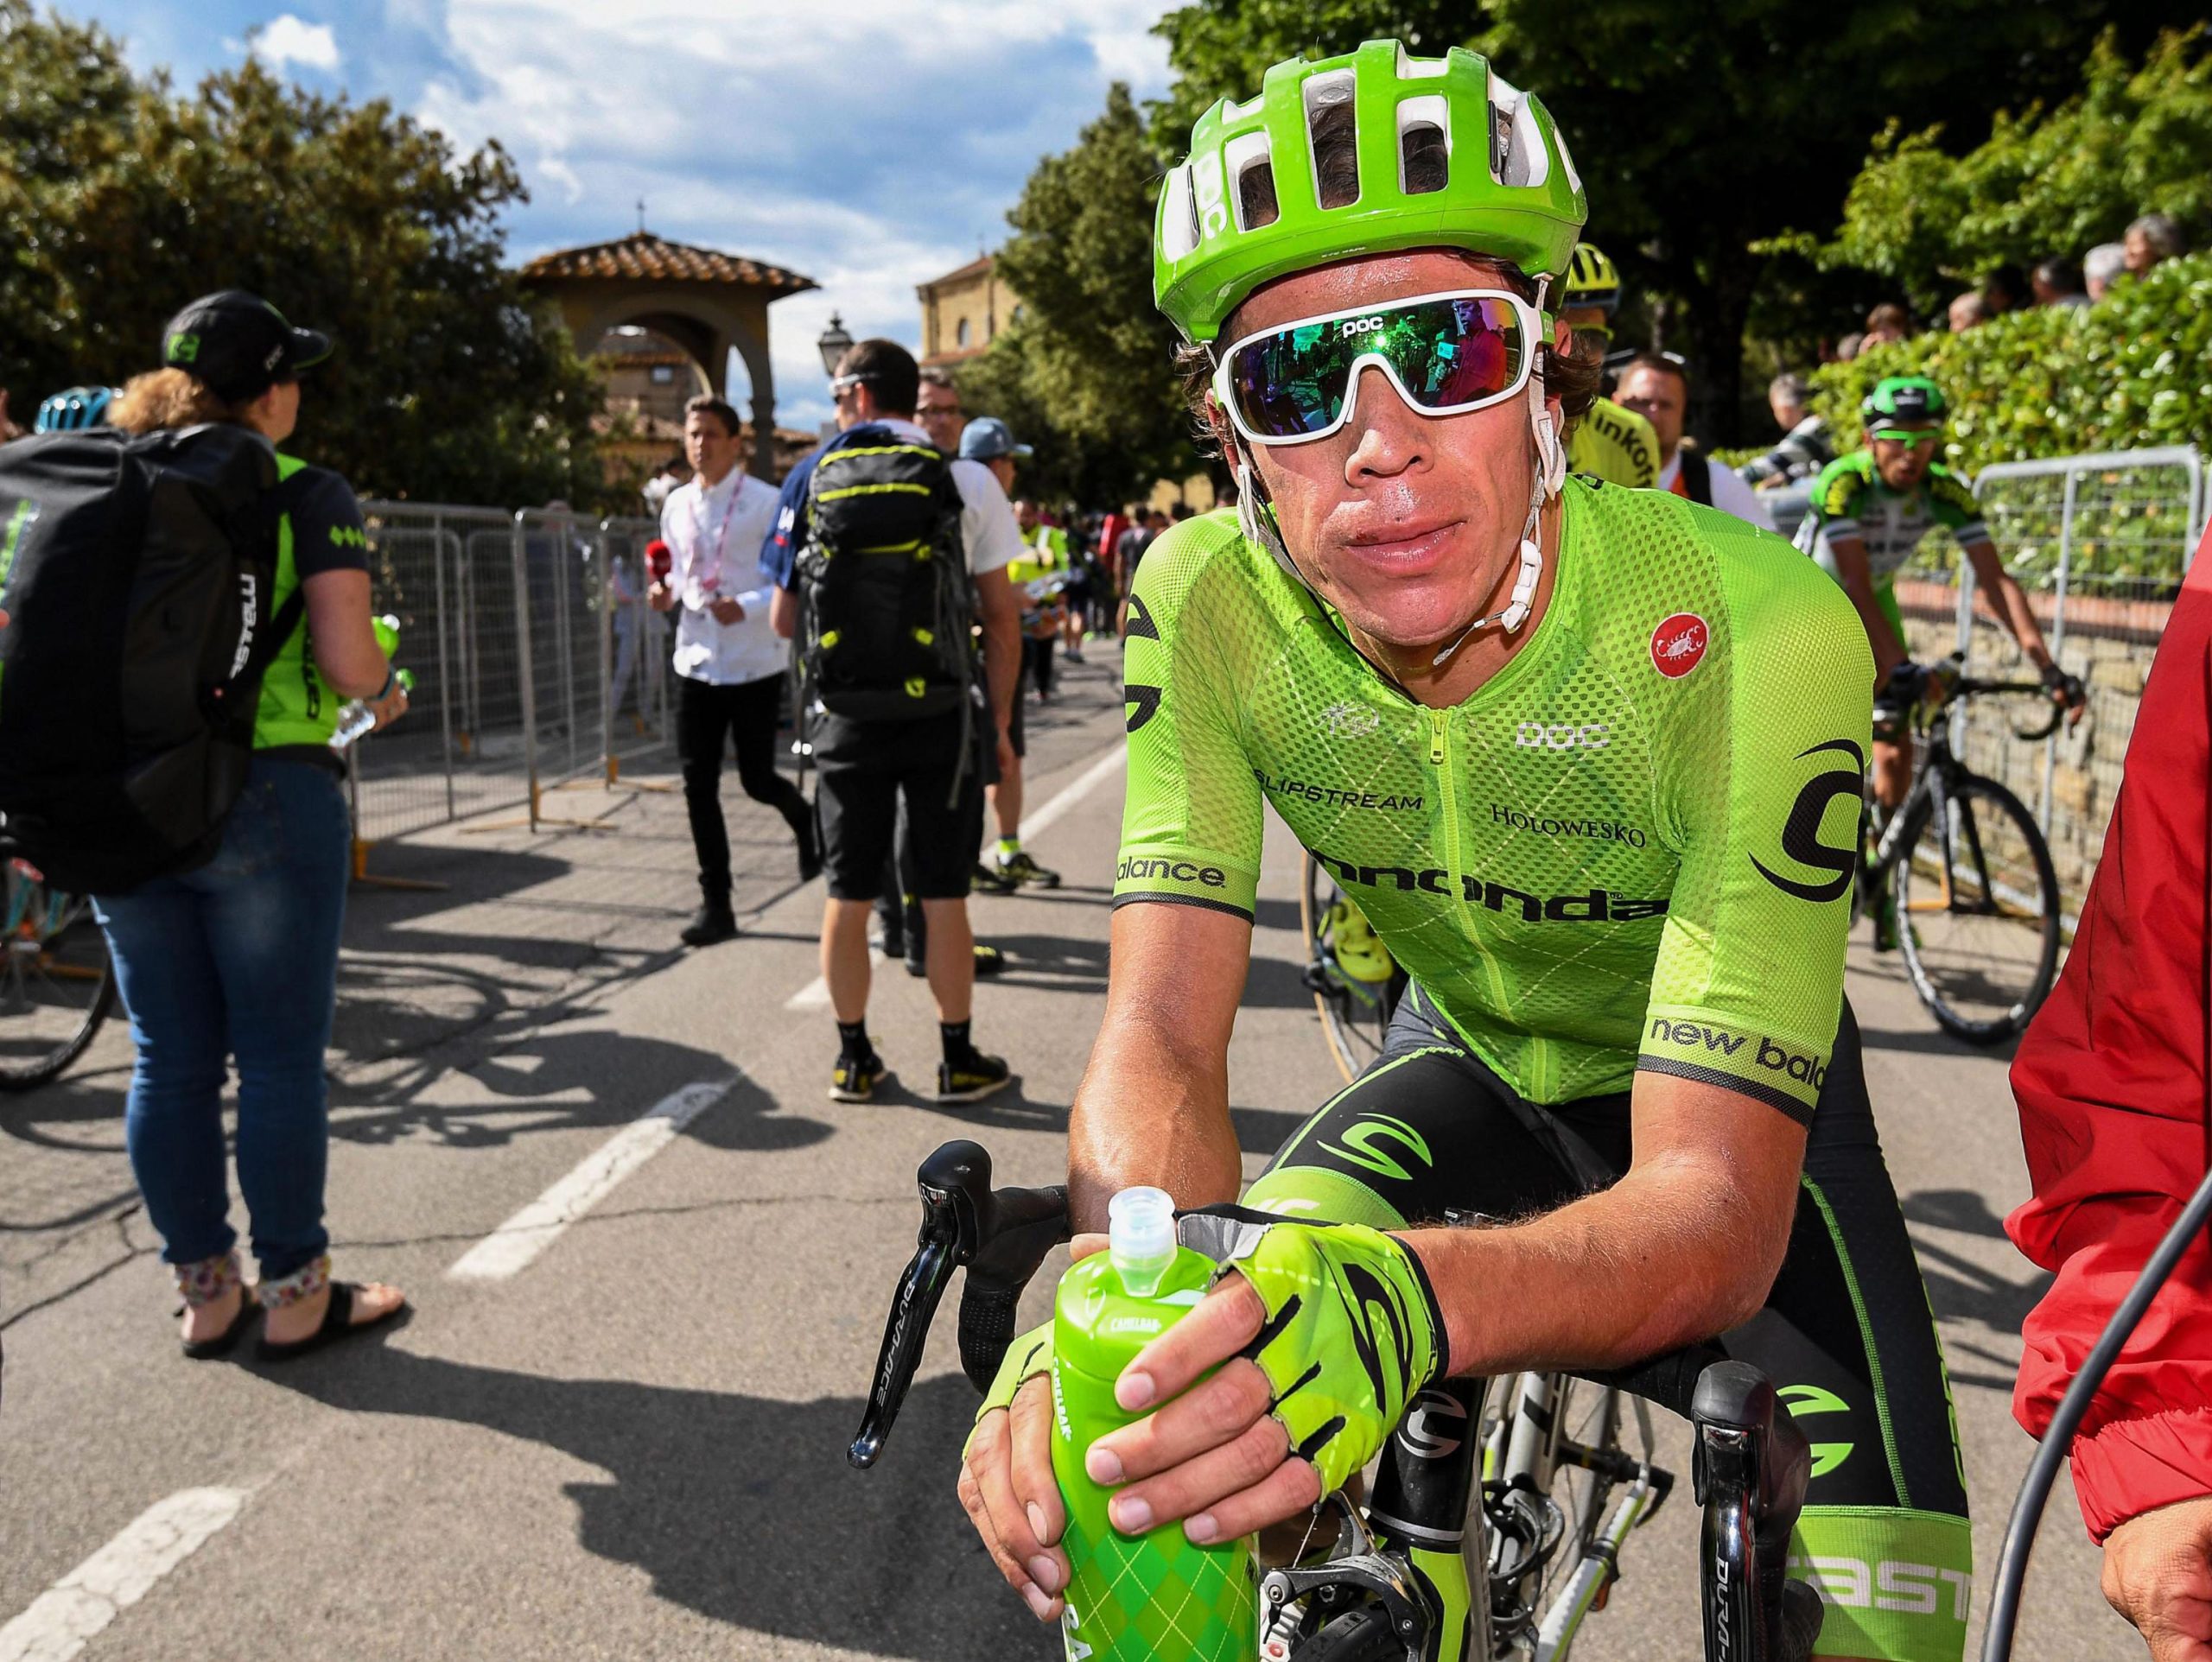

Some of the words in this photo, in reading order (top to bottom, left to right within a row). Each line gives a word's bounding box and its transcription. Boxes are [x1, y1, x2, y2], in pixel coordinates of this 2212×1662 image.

[1342, 316, 1384, 339] poc
[1253, 768, 1423, 810] SLIPSTREAM
[1491, 803, 1646, 848] HOLOWESKO
[1651, 1018, 1746, 1055] new
[876, 1280, 915, 1407] DURA-ACE
